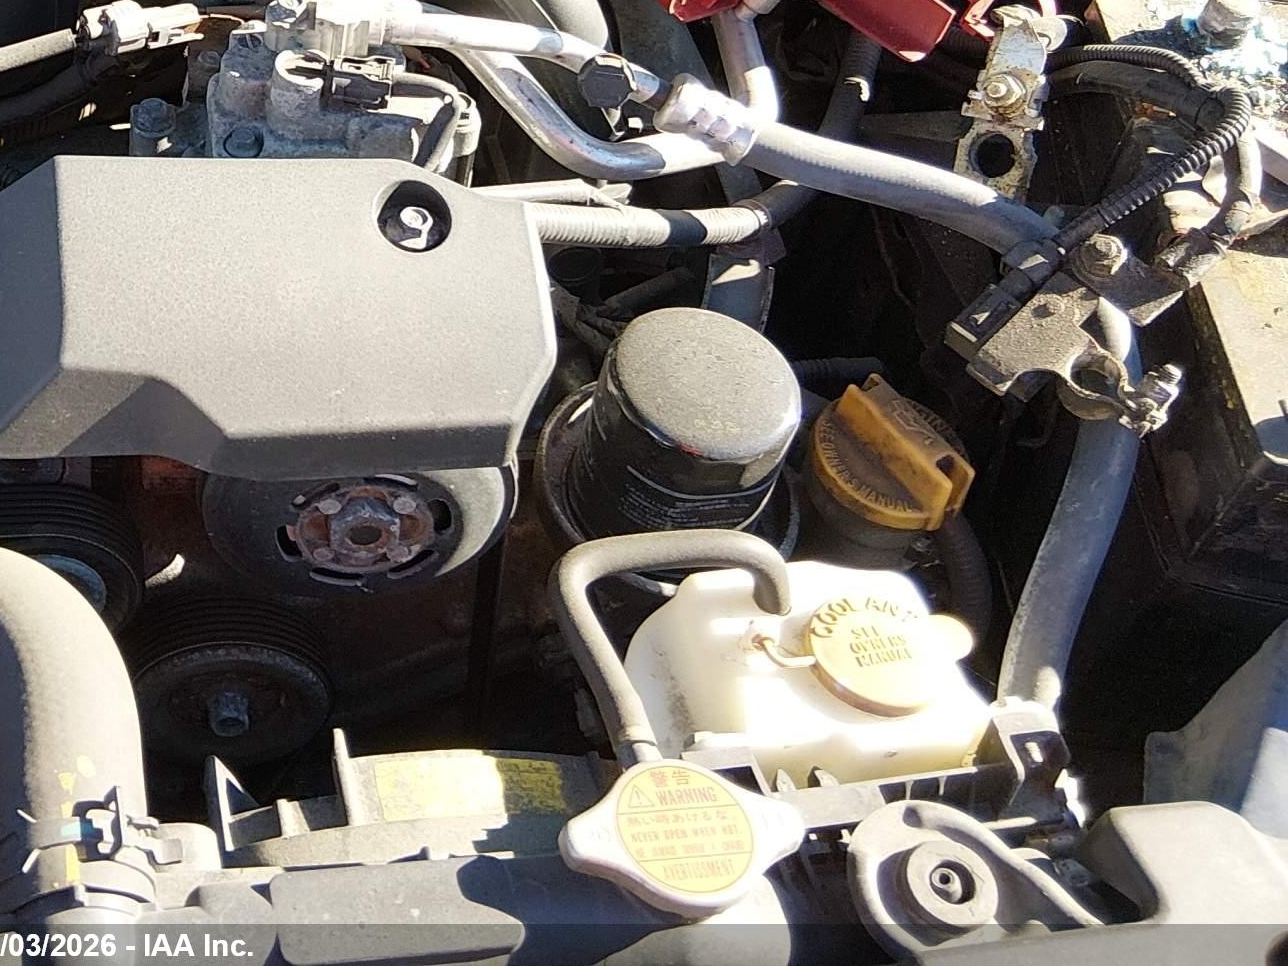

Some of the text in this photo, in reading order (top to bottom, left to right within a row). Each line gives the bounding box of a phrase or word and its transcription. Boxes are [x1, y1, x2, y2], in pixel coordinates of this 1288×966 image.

[858, 484, 914, 513] MANUAL
[854, 647, 914, 668] MANUAL
[655, 786, 718, 807] WARNING
[630, 831, 660, 843] NEVER
[664, 828, 688, 840] OPEN
